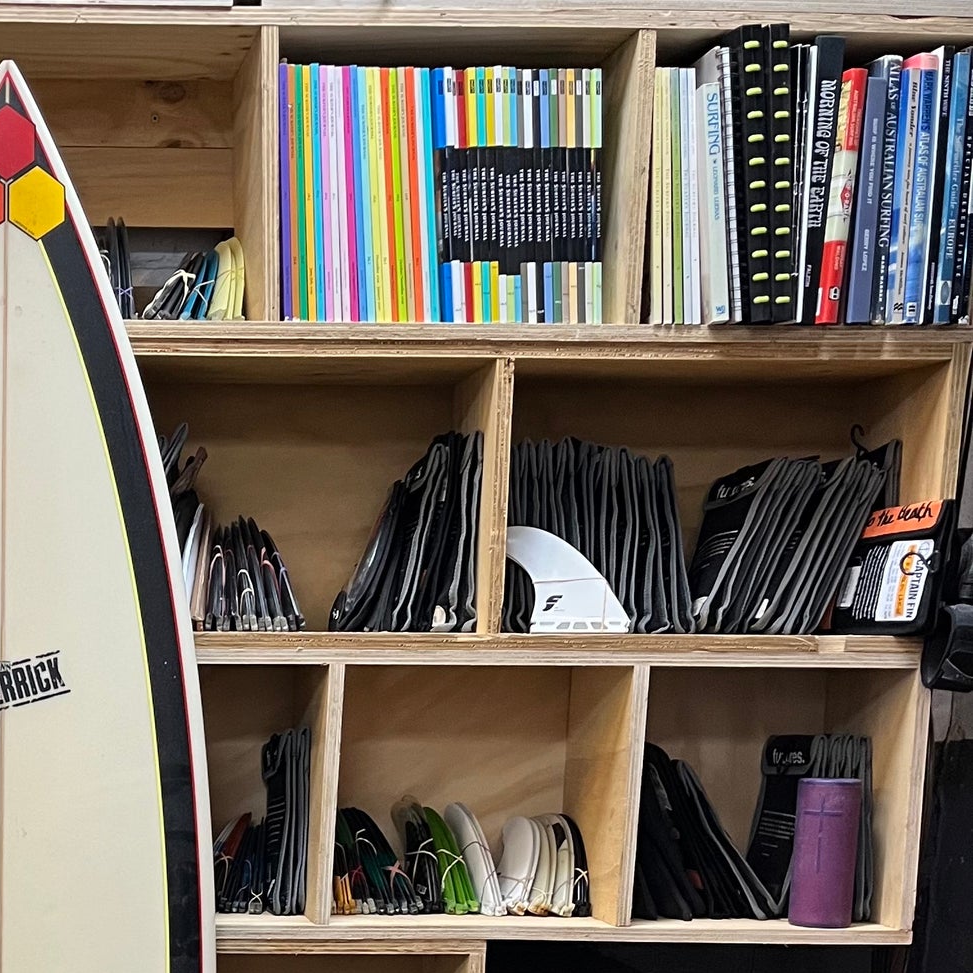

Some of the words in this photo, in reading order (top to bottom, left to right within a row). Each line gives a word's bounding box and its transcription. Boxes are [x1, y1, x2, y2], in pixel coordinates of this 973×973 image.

[888, 62, 902, 100] ATLAS
[707, 93, 720, 156] SURFING
[816, 80, 837, 138] MORNING
[814, 141, 830, 156] OF
[880, 112, 898, 190] AUSTRALIAN
[918, 157, 928, 166] OF
[920, 131, 930, 154] ATLAS
[811, 159, 828, 183] THE
[914, 168, 927, 211] AUSTRALIAN
[808, 187, 825, 228] EARTH
[878, 192, 892, 248] SURFING
[946, 218, 955, 260] EUROPE
[908, 560, 924, 600] CAPTAIN
[906, 603, 915, 618] FIN
[773, 748, 805, 764] fuures.
